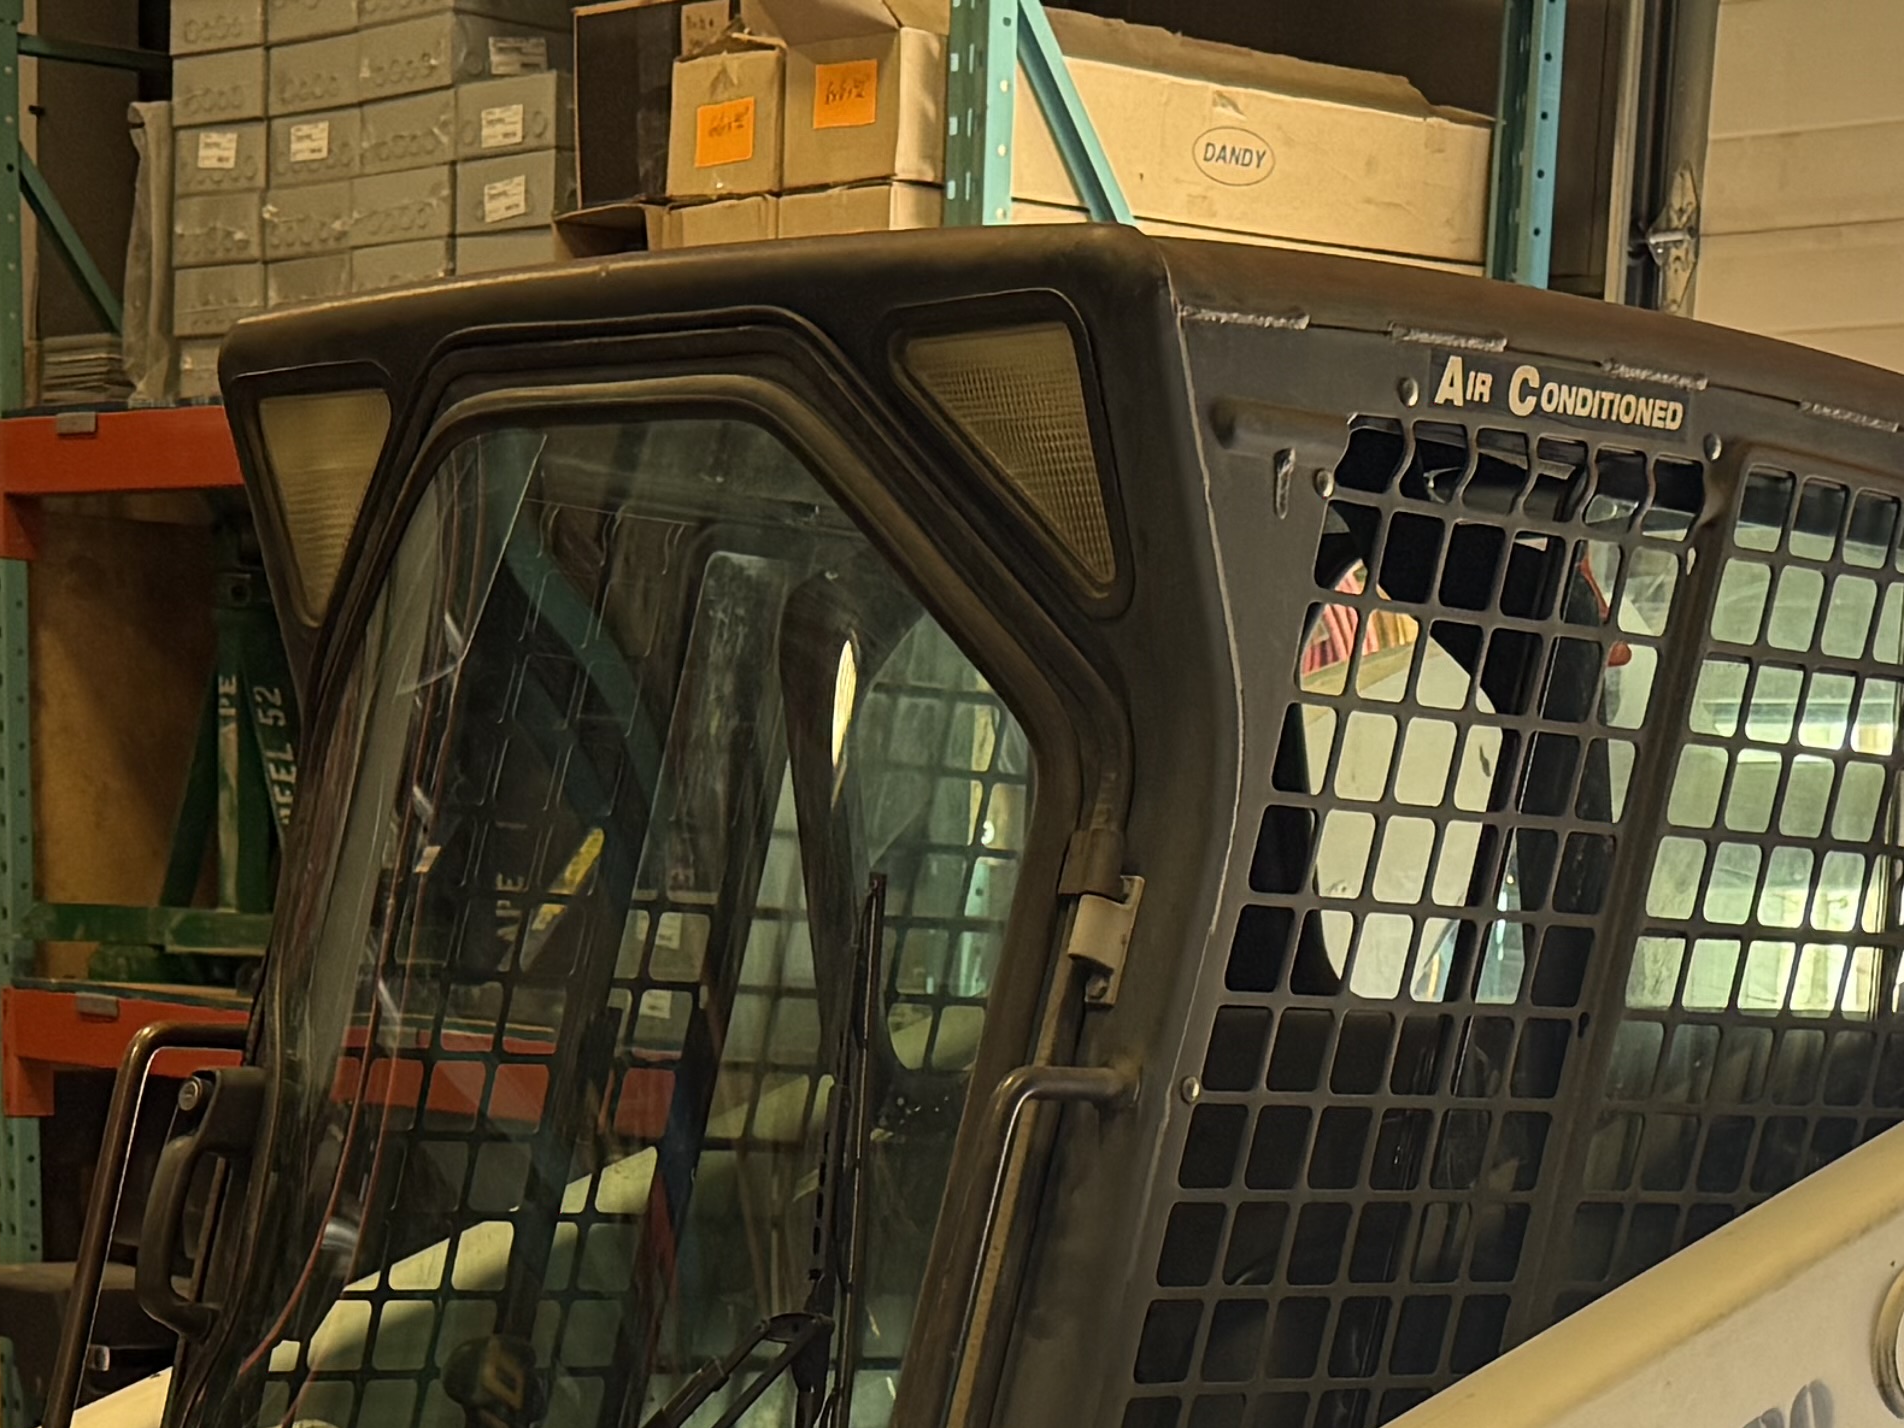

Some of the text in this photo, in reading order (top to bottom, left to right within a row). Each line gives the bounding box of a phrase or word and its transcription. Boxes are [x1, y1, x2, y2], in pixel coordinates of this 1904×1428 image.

[1203, 141, 1267, 169] DANDY
[1507, 364, 1684, 431] CONDITIONED
[252, 686, 287, 728] 52
